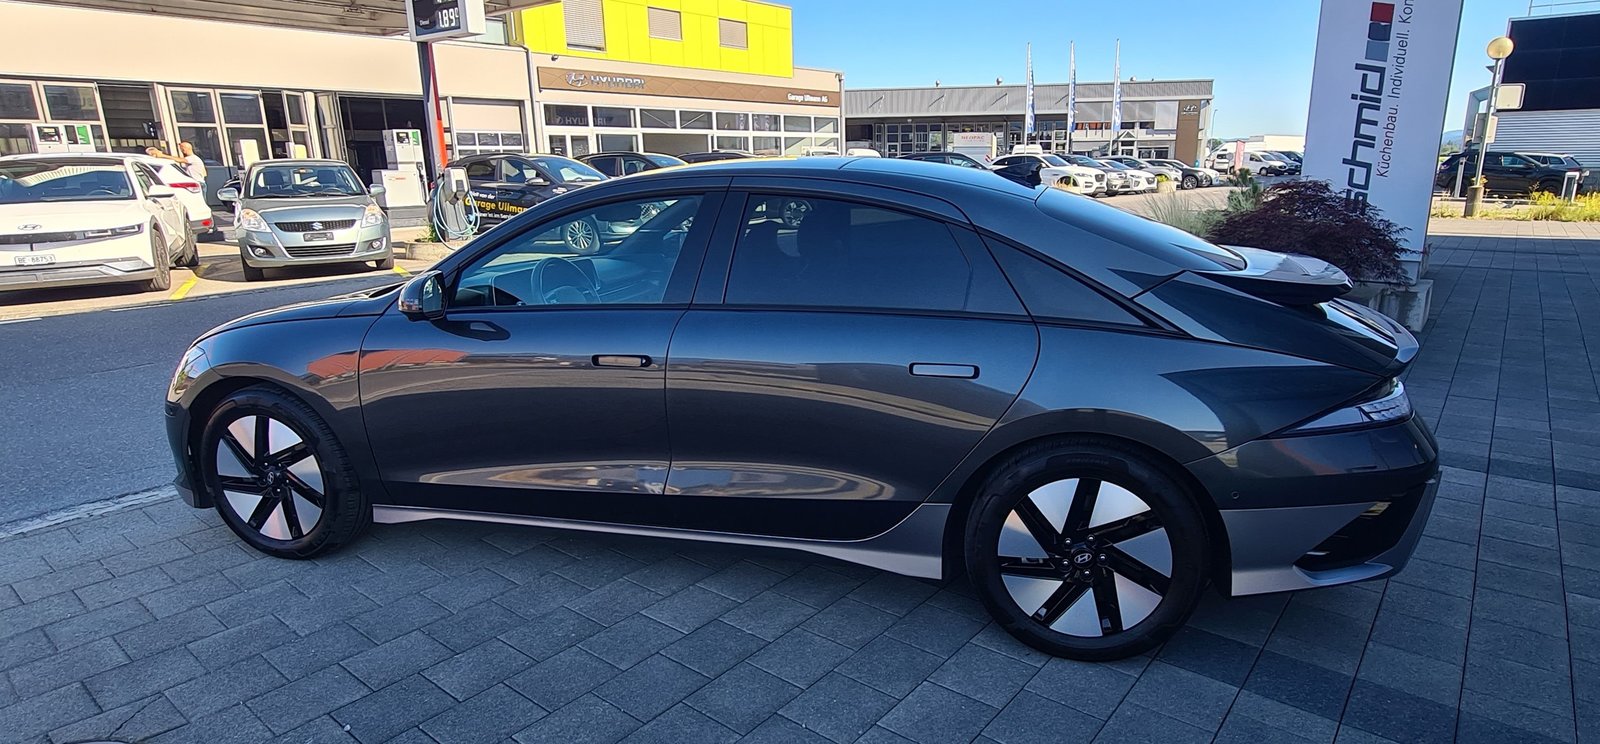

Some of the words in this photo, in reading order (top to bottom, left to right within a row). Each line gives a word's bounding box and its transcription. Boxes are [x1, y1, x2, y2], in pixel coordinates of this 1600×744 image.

[1387, 29, 1410, 99] Individuell.
[590, 75, 645, 88] HYUNDAI
[565, 116, 607, 126] HYUAI
[1376, 103, 1399, 178] Küchenbau.
[465, 198, 496, 210] Grage
[498, 201, 529, 214] Ullman
